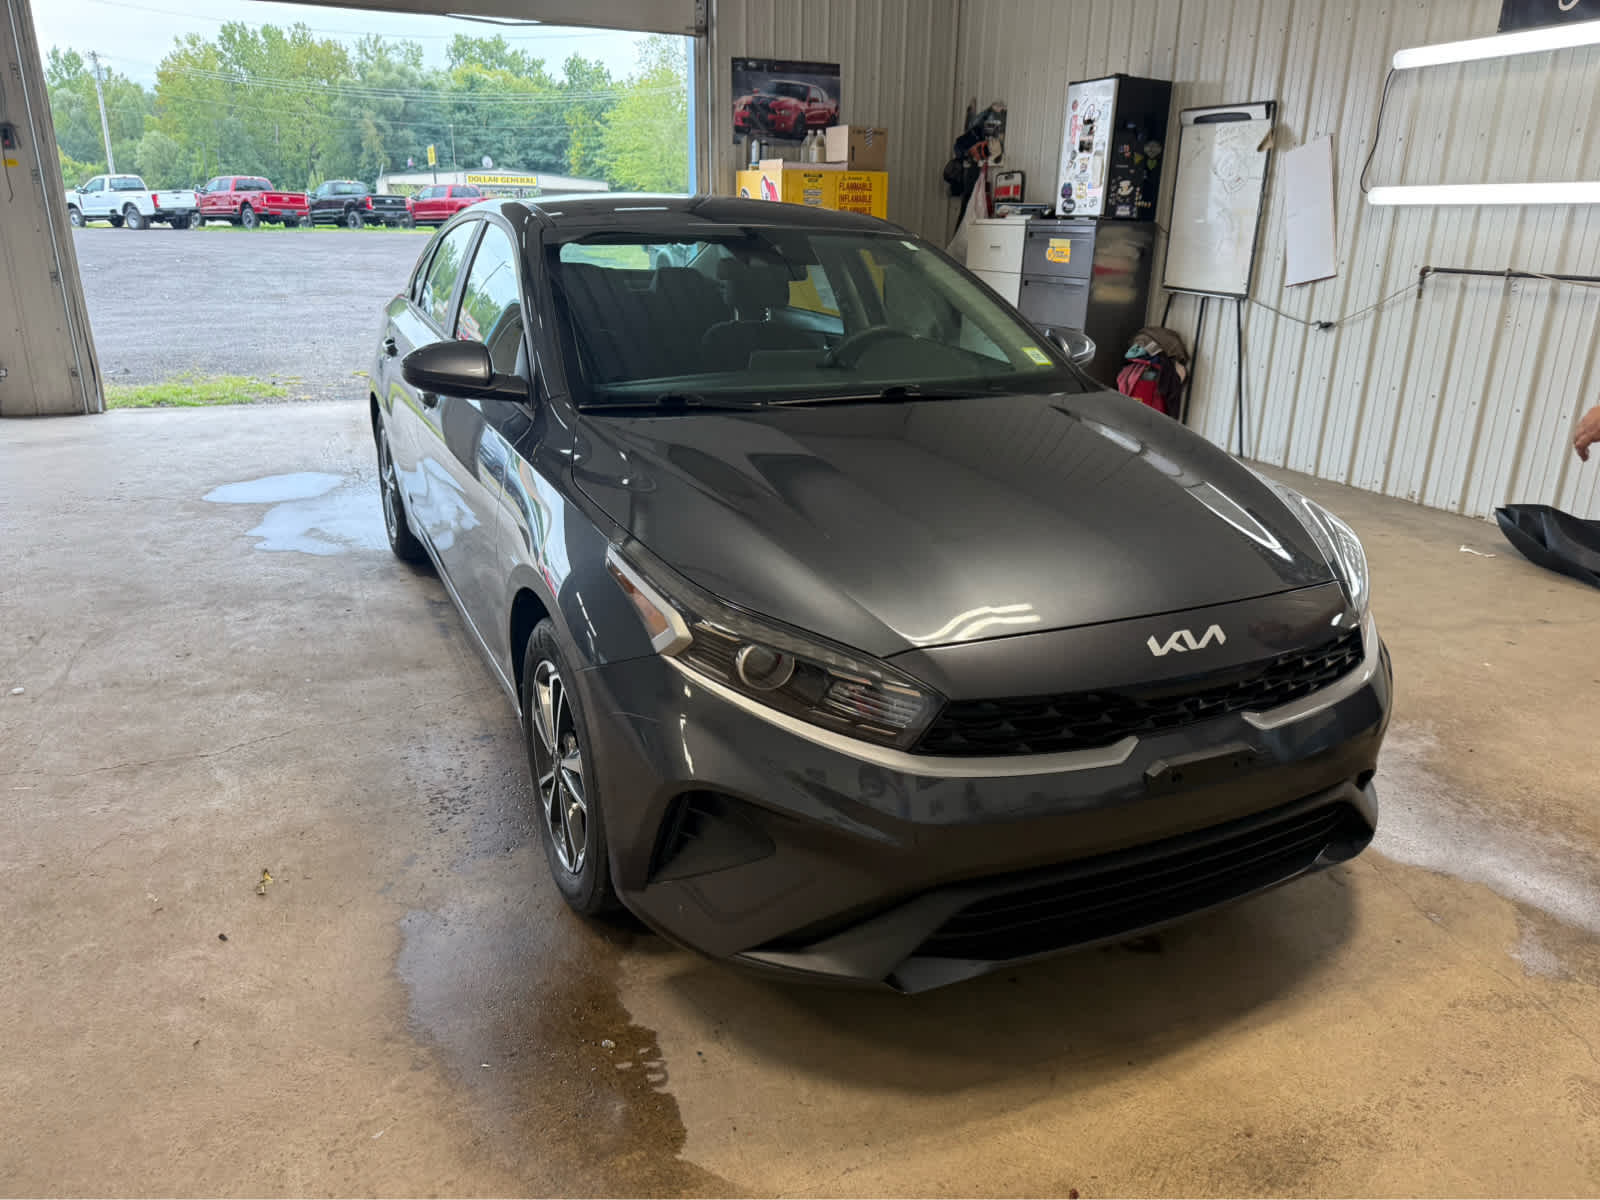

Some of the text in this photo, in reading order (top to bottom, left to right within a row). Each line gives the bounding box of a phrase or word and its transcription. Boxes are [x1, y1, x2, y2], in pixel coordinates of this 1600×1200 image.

[468, 175, 536, 184] DOLLAR GENERAL
[839, 181, 873, 191] FLAMMABLE
[1147, 624, 1227, 656] KIA
